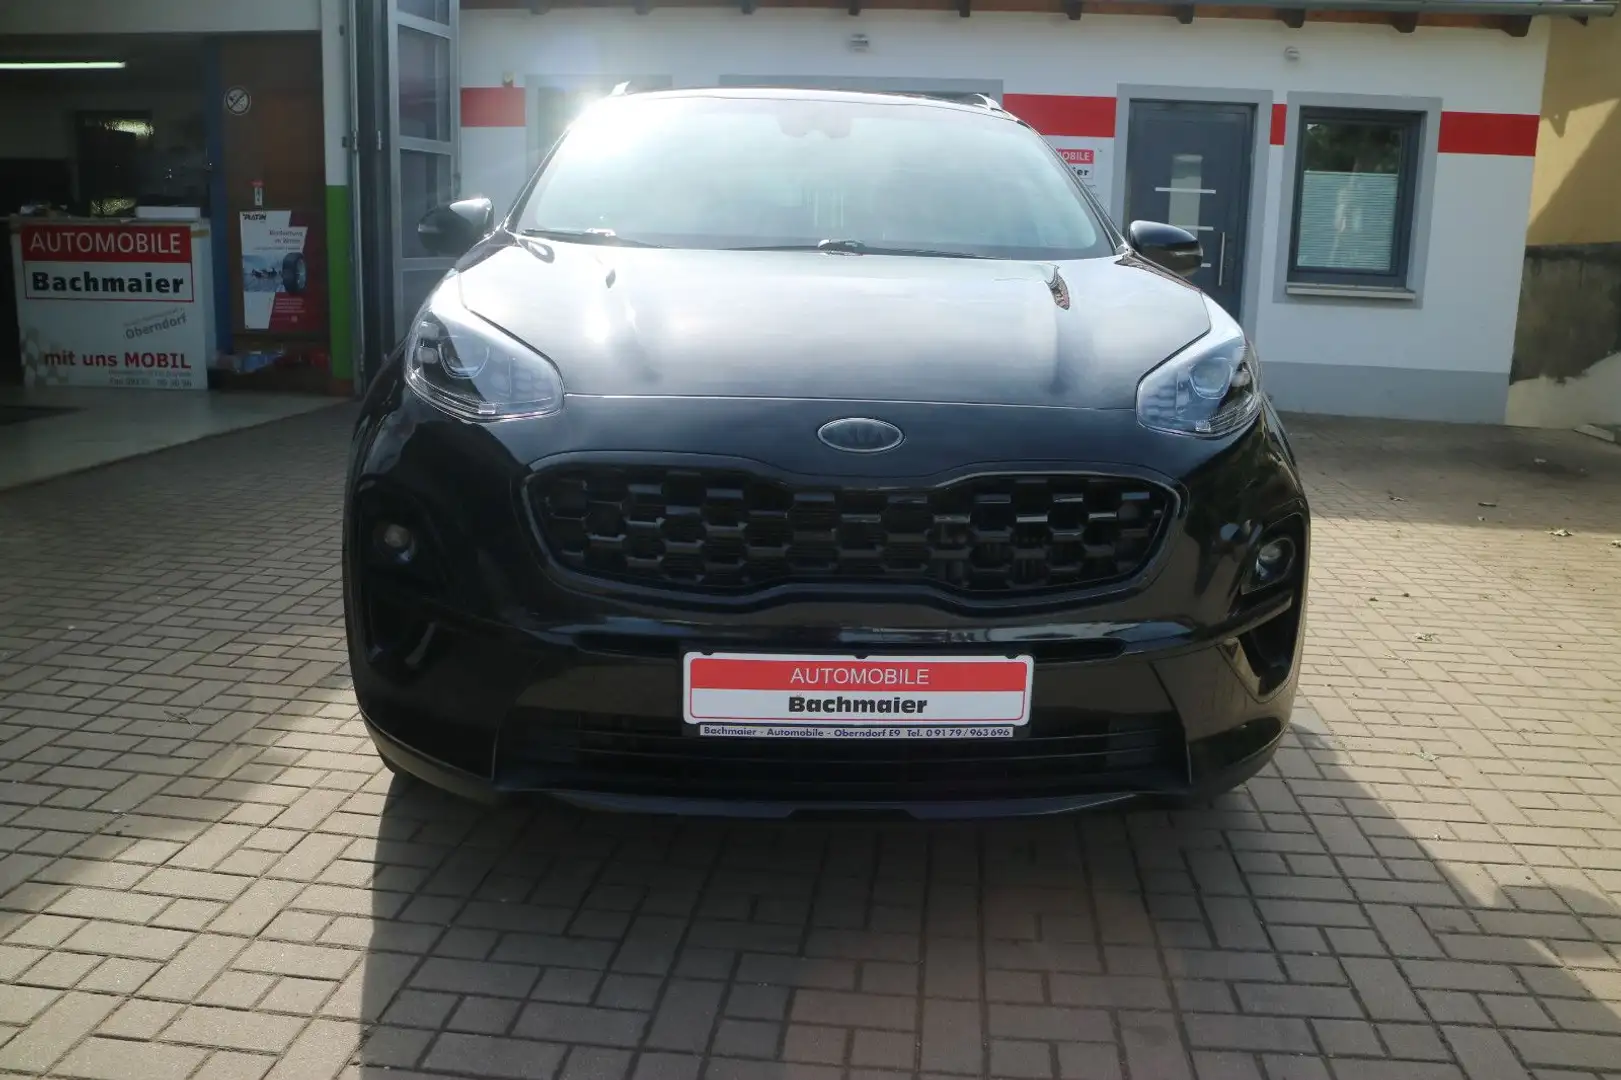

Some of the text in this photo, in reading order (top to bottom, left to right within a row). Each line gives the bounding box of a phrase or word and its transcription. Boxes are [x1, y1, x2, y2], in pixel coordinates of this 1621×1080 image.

[29, 231, 181, 254] AUTOMOBILE
[32, 271, 184, 294] Bachmaier
[125, 311, 187, 339] Oberndorf
[44, 351, 191, 369] mit uns MOBIL
[789, 667, 929, 685] AUTOMOBILE
[788, 696, 928, 713] Bachmaier
[703, 726, 756, 736] Bachmaier
[766, 728, 824, 737] Automobile
[834, 728, 886, 737] Oberndorf
[889, 729, 901, 737] E9
[906, 729, 923, 737] Tel.
